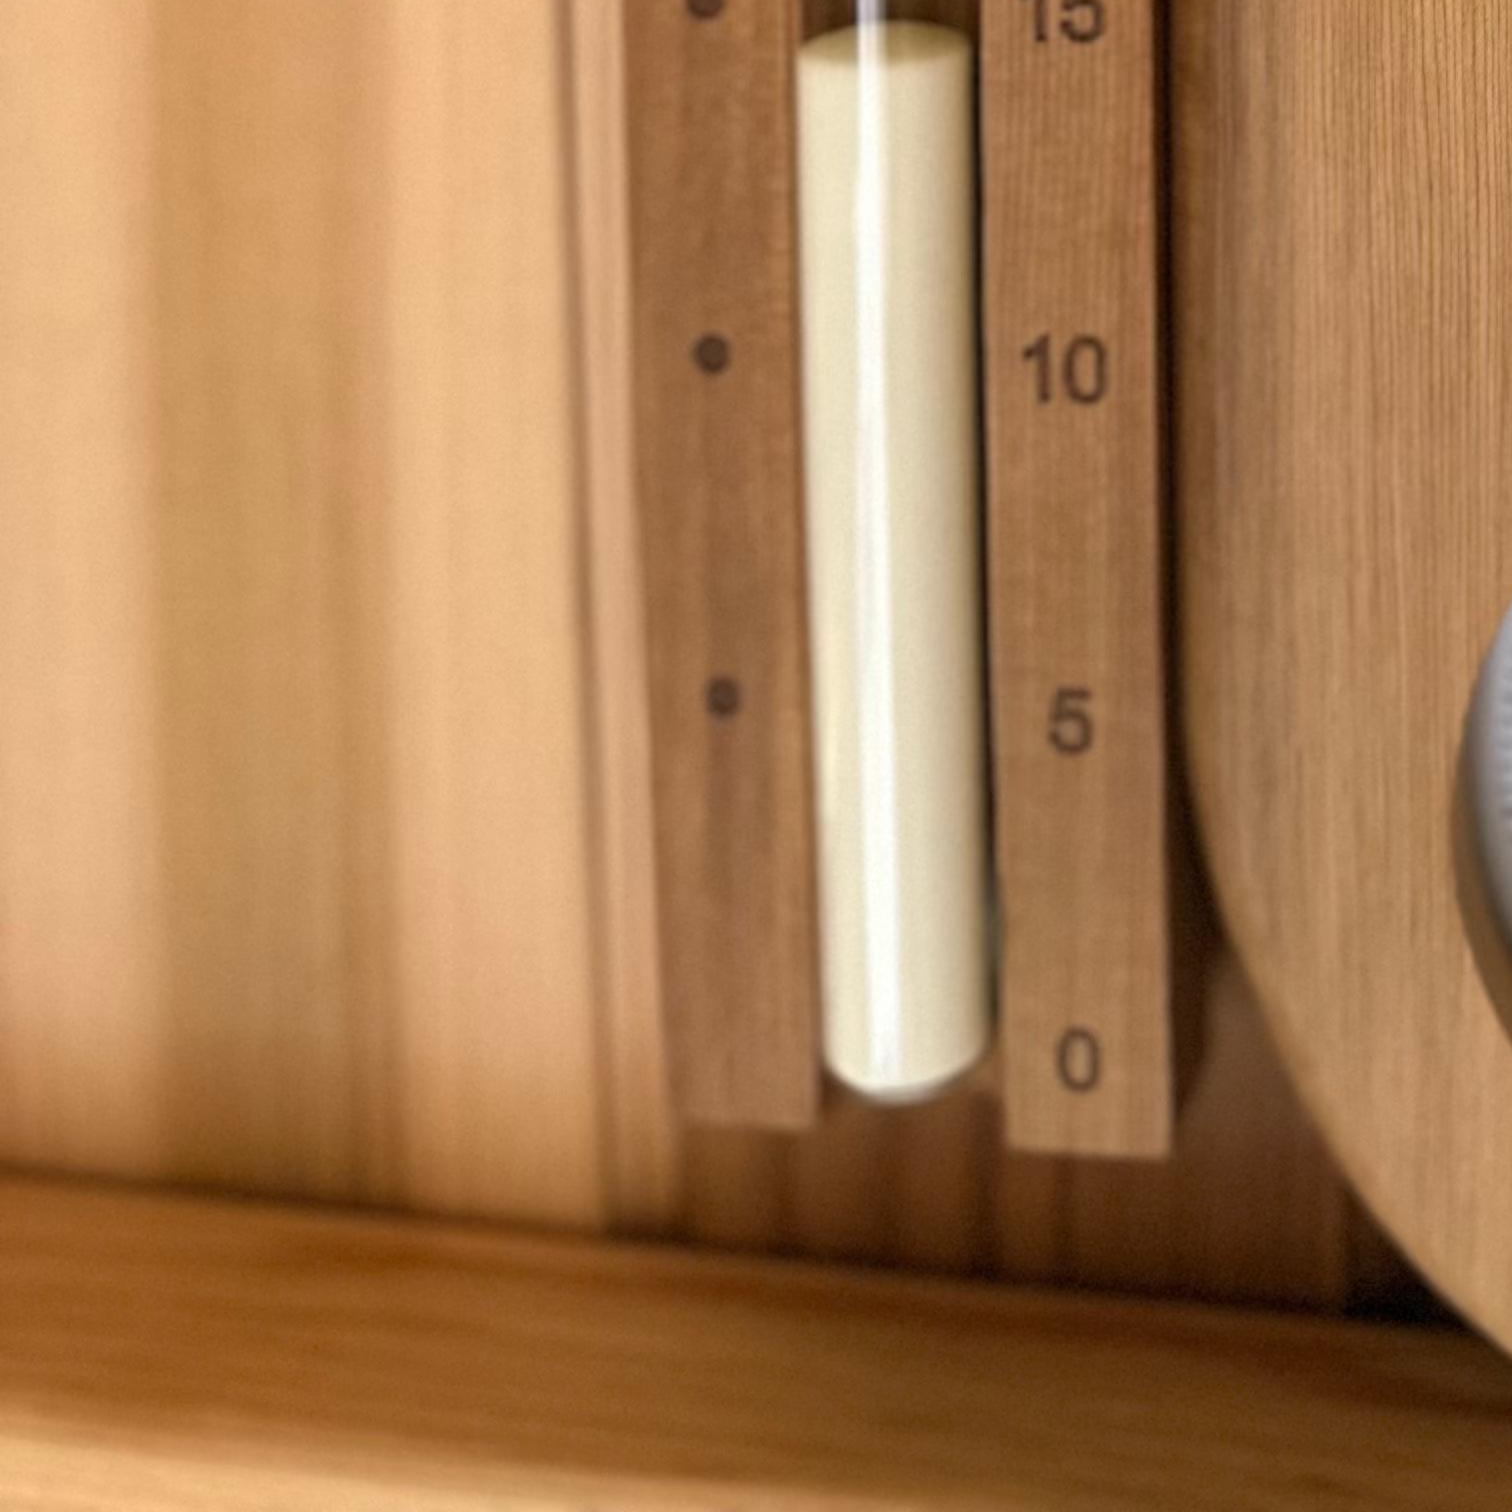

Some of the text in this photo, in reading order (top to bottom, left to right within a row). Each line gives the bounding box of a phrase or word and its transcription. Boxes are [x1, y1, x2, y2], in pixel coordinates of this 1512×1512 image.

[1023, 334, 1108, 405] 10
[1048, 689, 1094, 756] 5
[1058, 1027, 1100, 1092] 0
